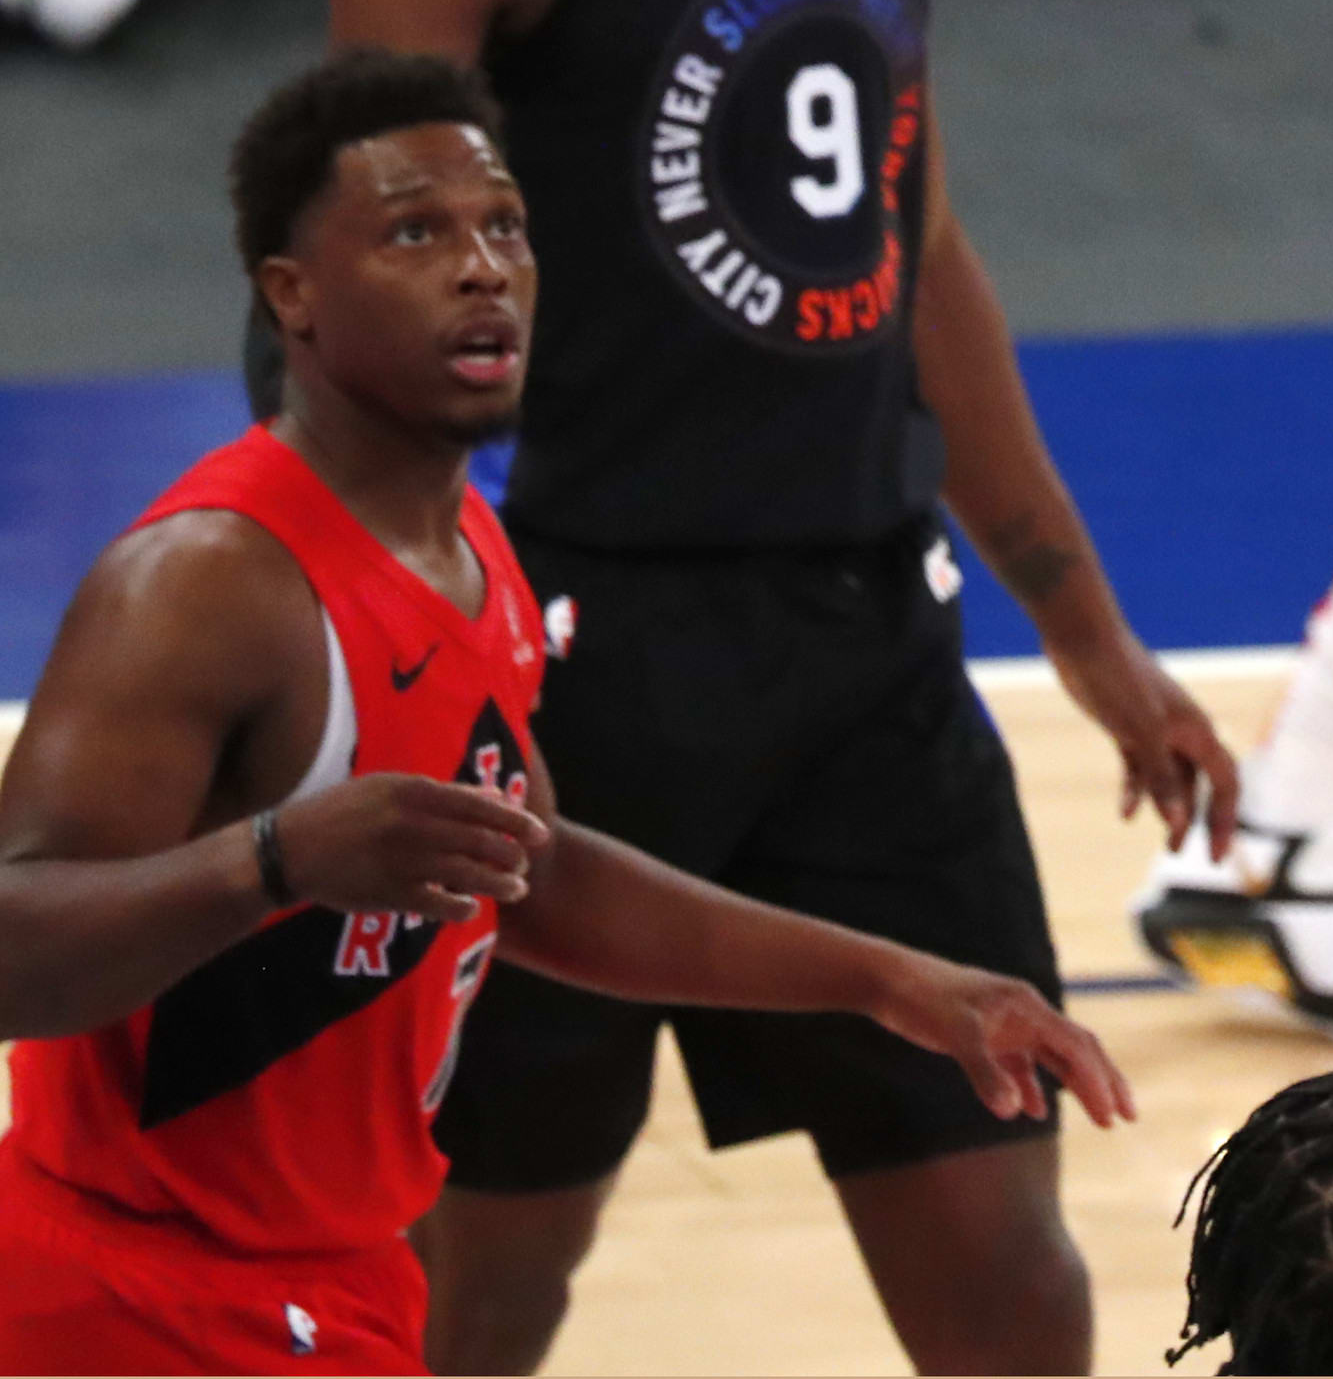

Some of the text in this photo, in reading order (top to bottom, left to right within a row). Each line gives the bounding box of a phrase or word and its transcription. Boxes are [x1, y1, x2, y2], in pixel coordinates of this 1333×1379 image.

[651, 53, 724, 222] NEVER
[785, 63, 864, 218] 9
[677, 228, 783, 325] CITY
